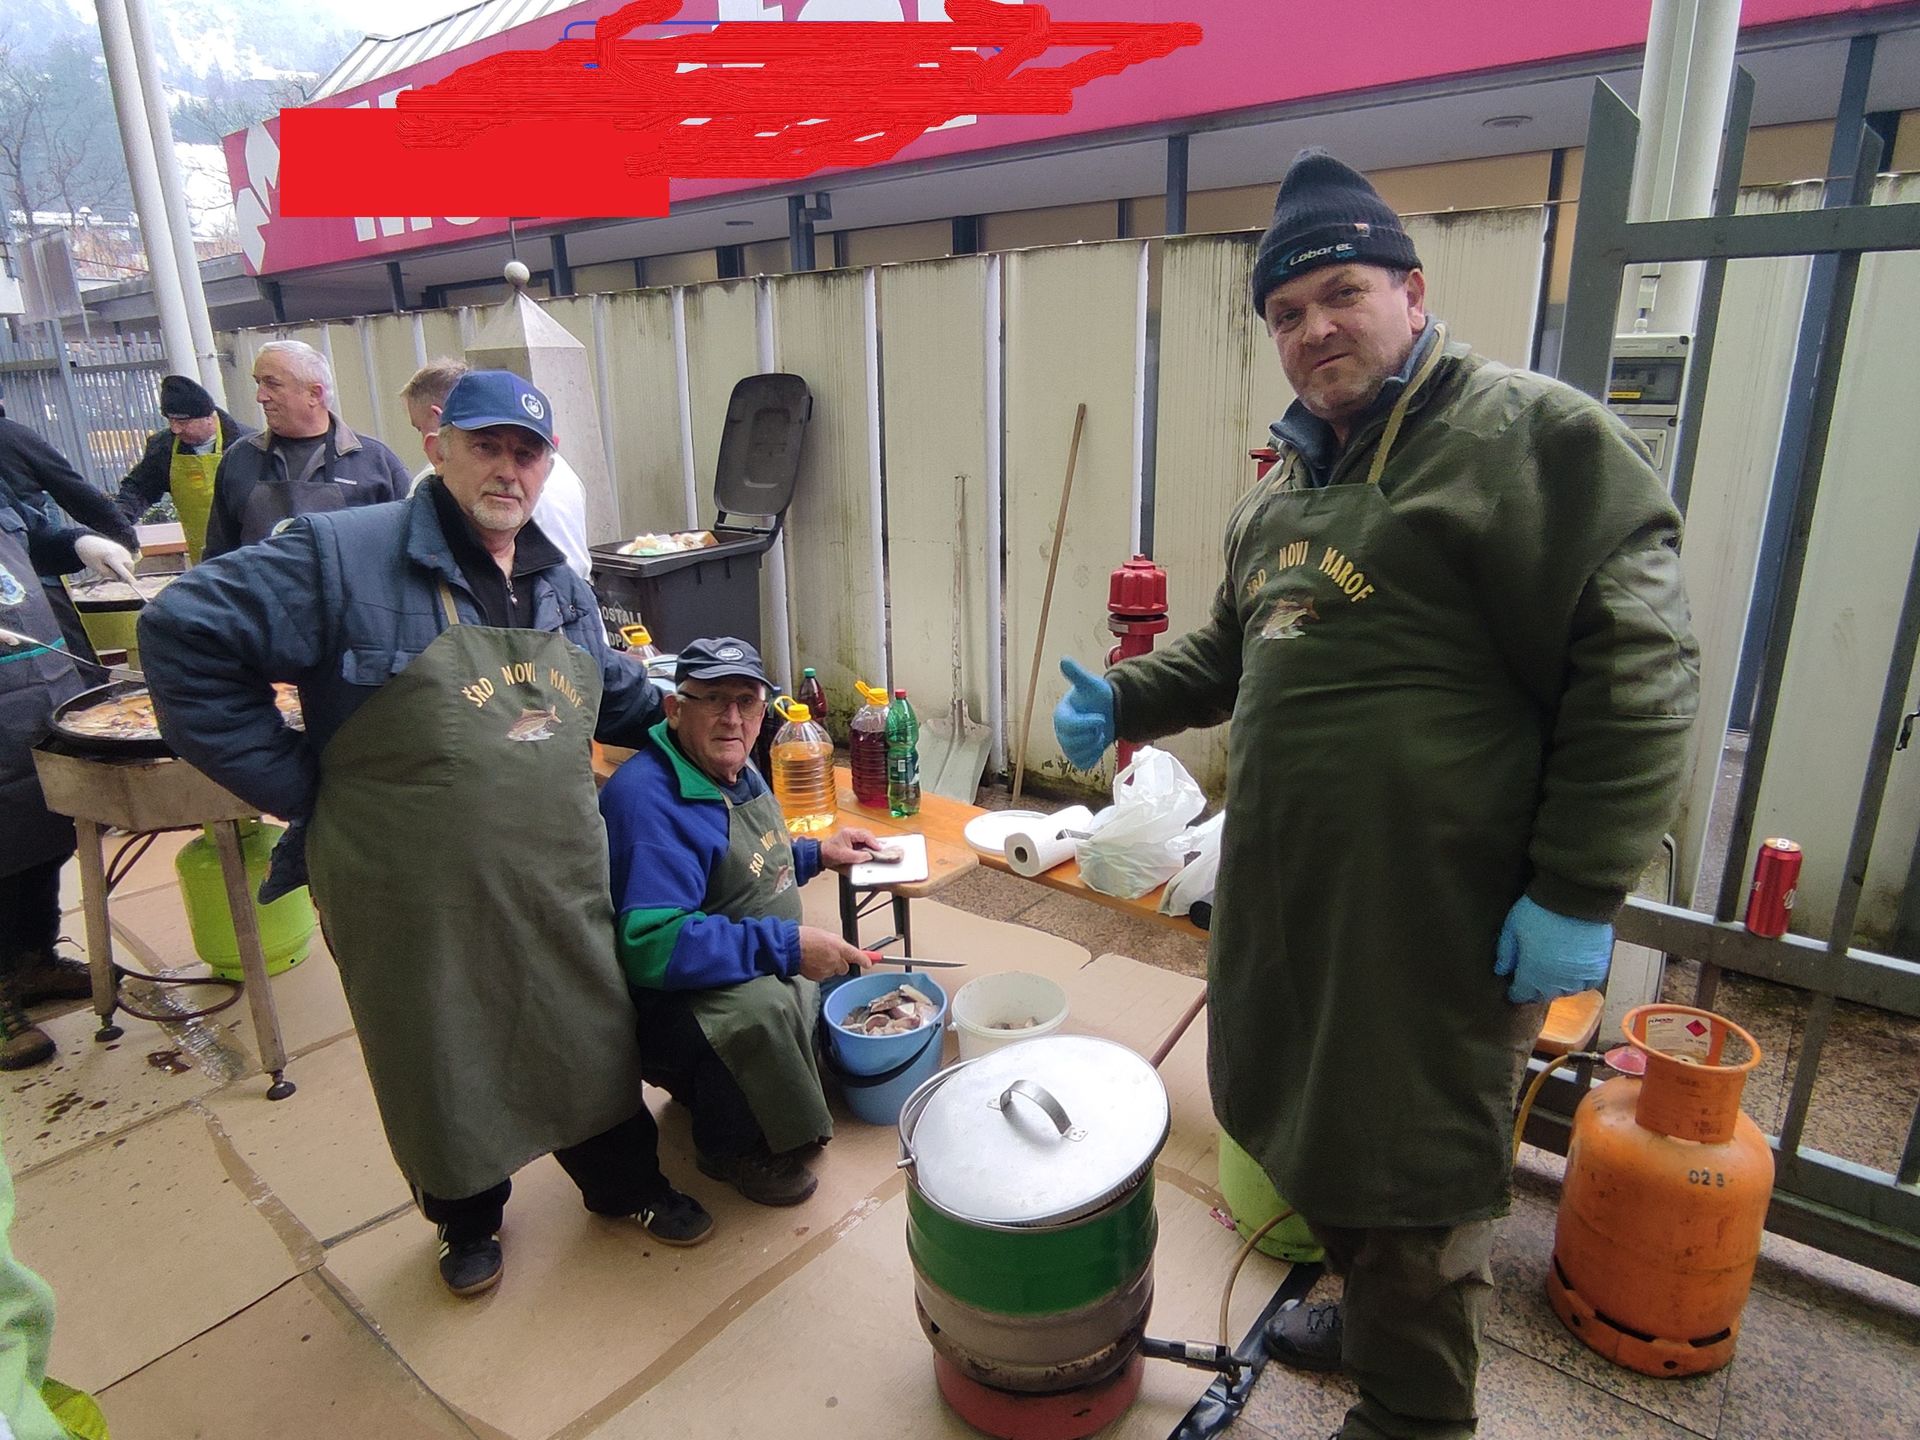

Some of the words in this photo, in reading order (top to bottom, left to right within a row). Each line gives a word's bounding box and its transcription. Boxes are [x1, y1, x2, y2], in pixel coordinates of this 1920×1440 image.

[1279, 541, 1309, 571] NOVI
[1318, 546, 1375, 602] MAROF
[601, 605, 642, 625] OSTALI
[461, 677, 495, 708] ŠRD
[501, 662, 536, 686] NOVI
